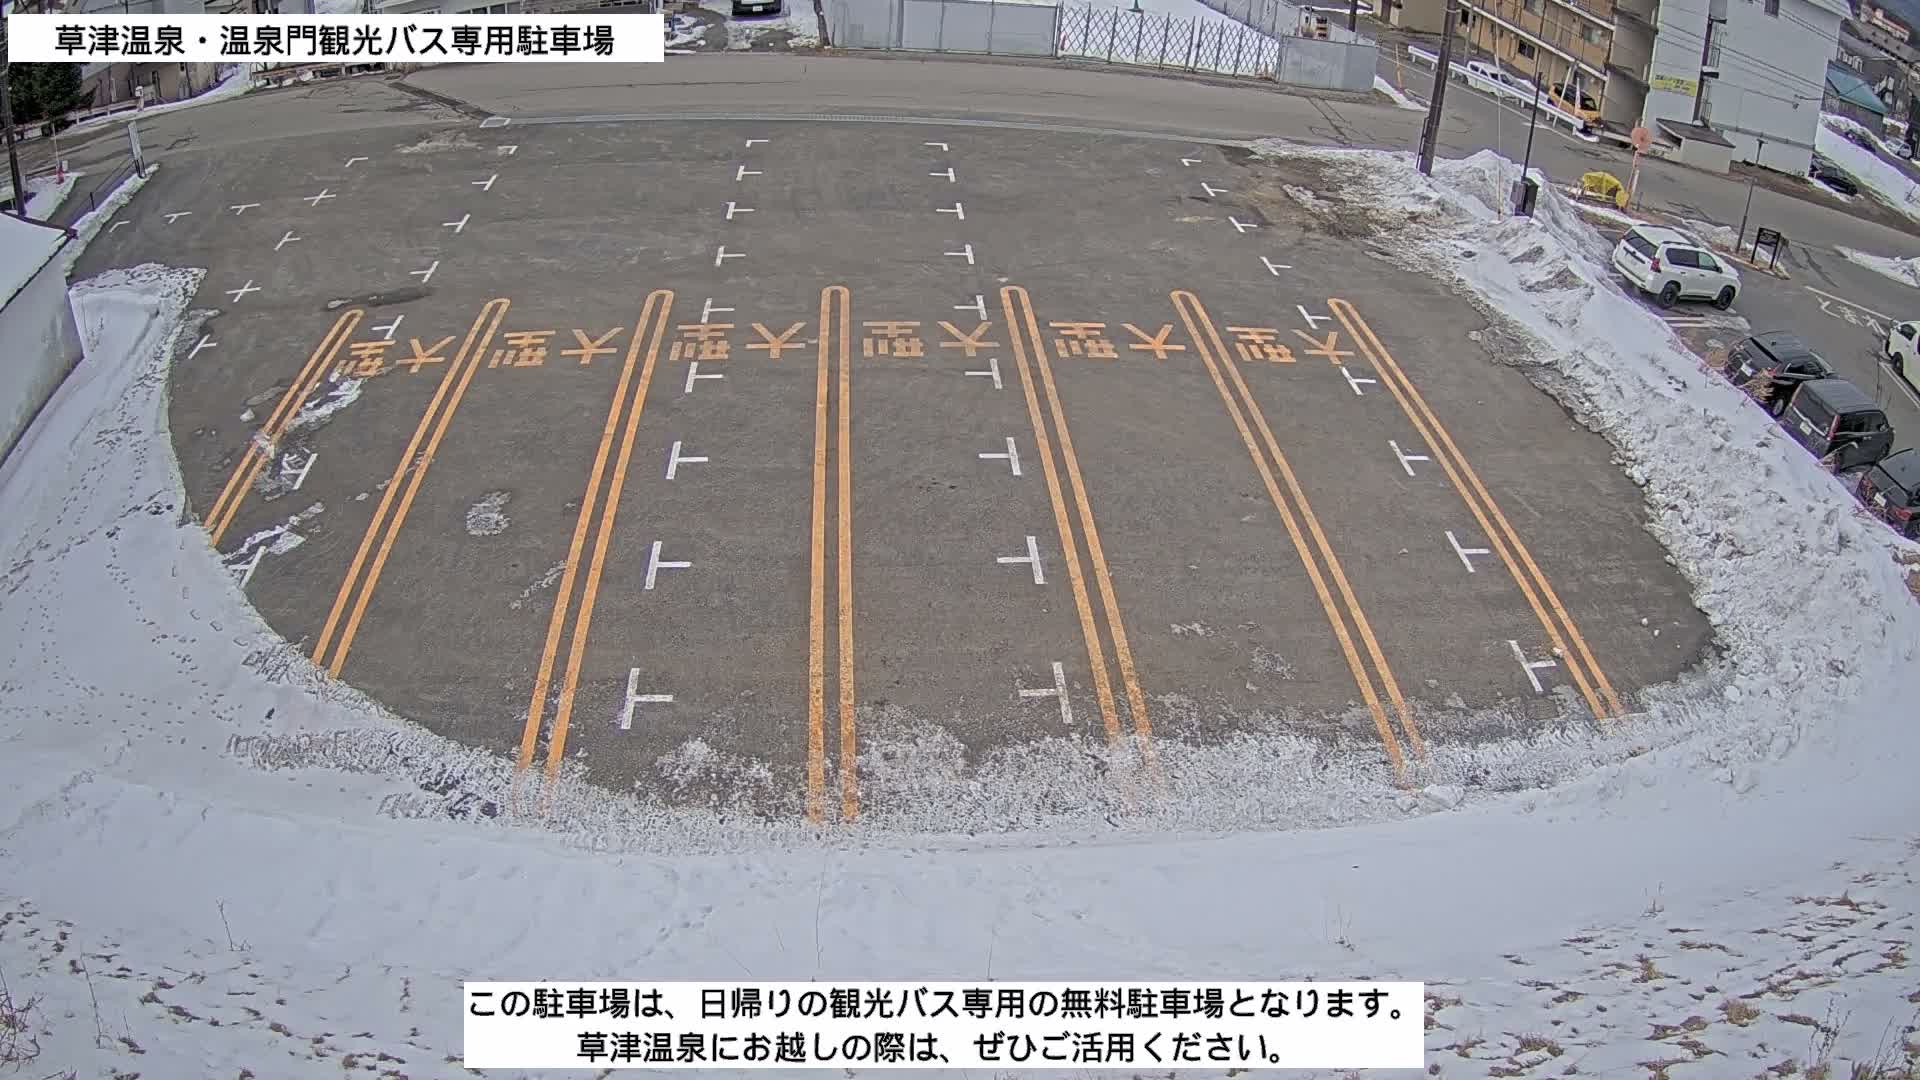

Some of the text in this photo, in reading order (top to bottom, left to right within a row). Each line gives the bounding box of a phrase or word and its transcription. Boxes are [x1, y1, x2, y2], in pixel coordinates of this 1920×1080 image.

[486, 326, 625, 370] 大型
[667, 321, 808, 362] 大型
[862, 320, 1001, 359] 大型
[1048, 321, 1188, 361] 大型
[1226, 326, 1356, 365] 大型
